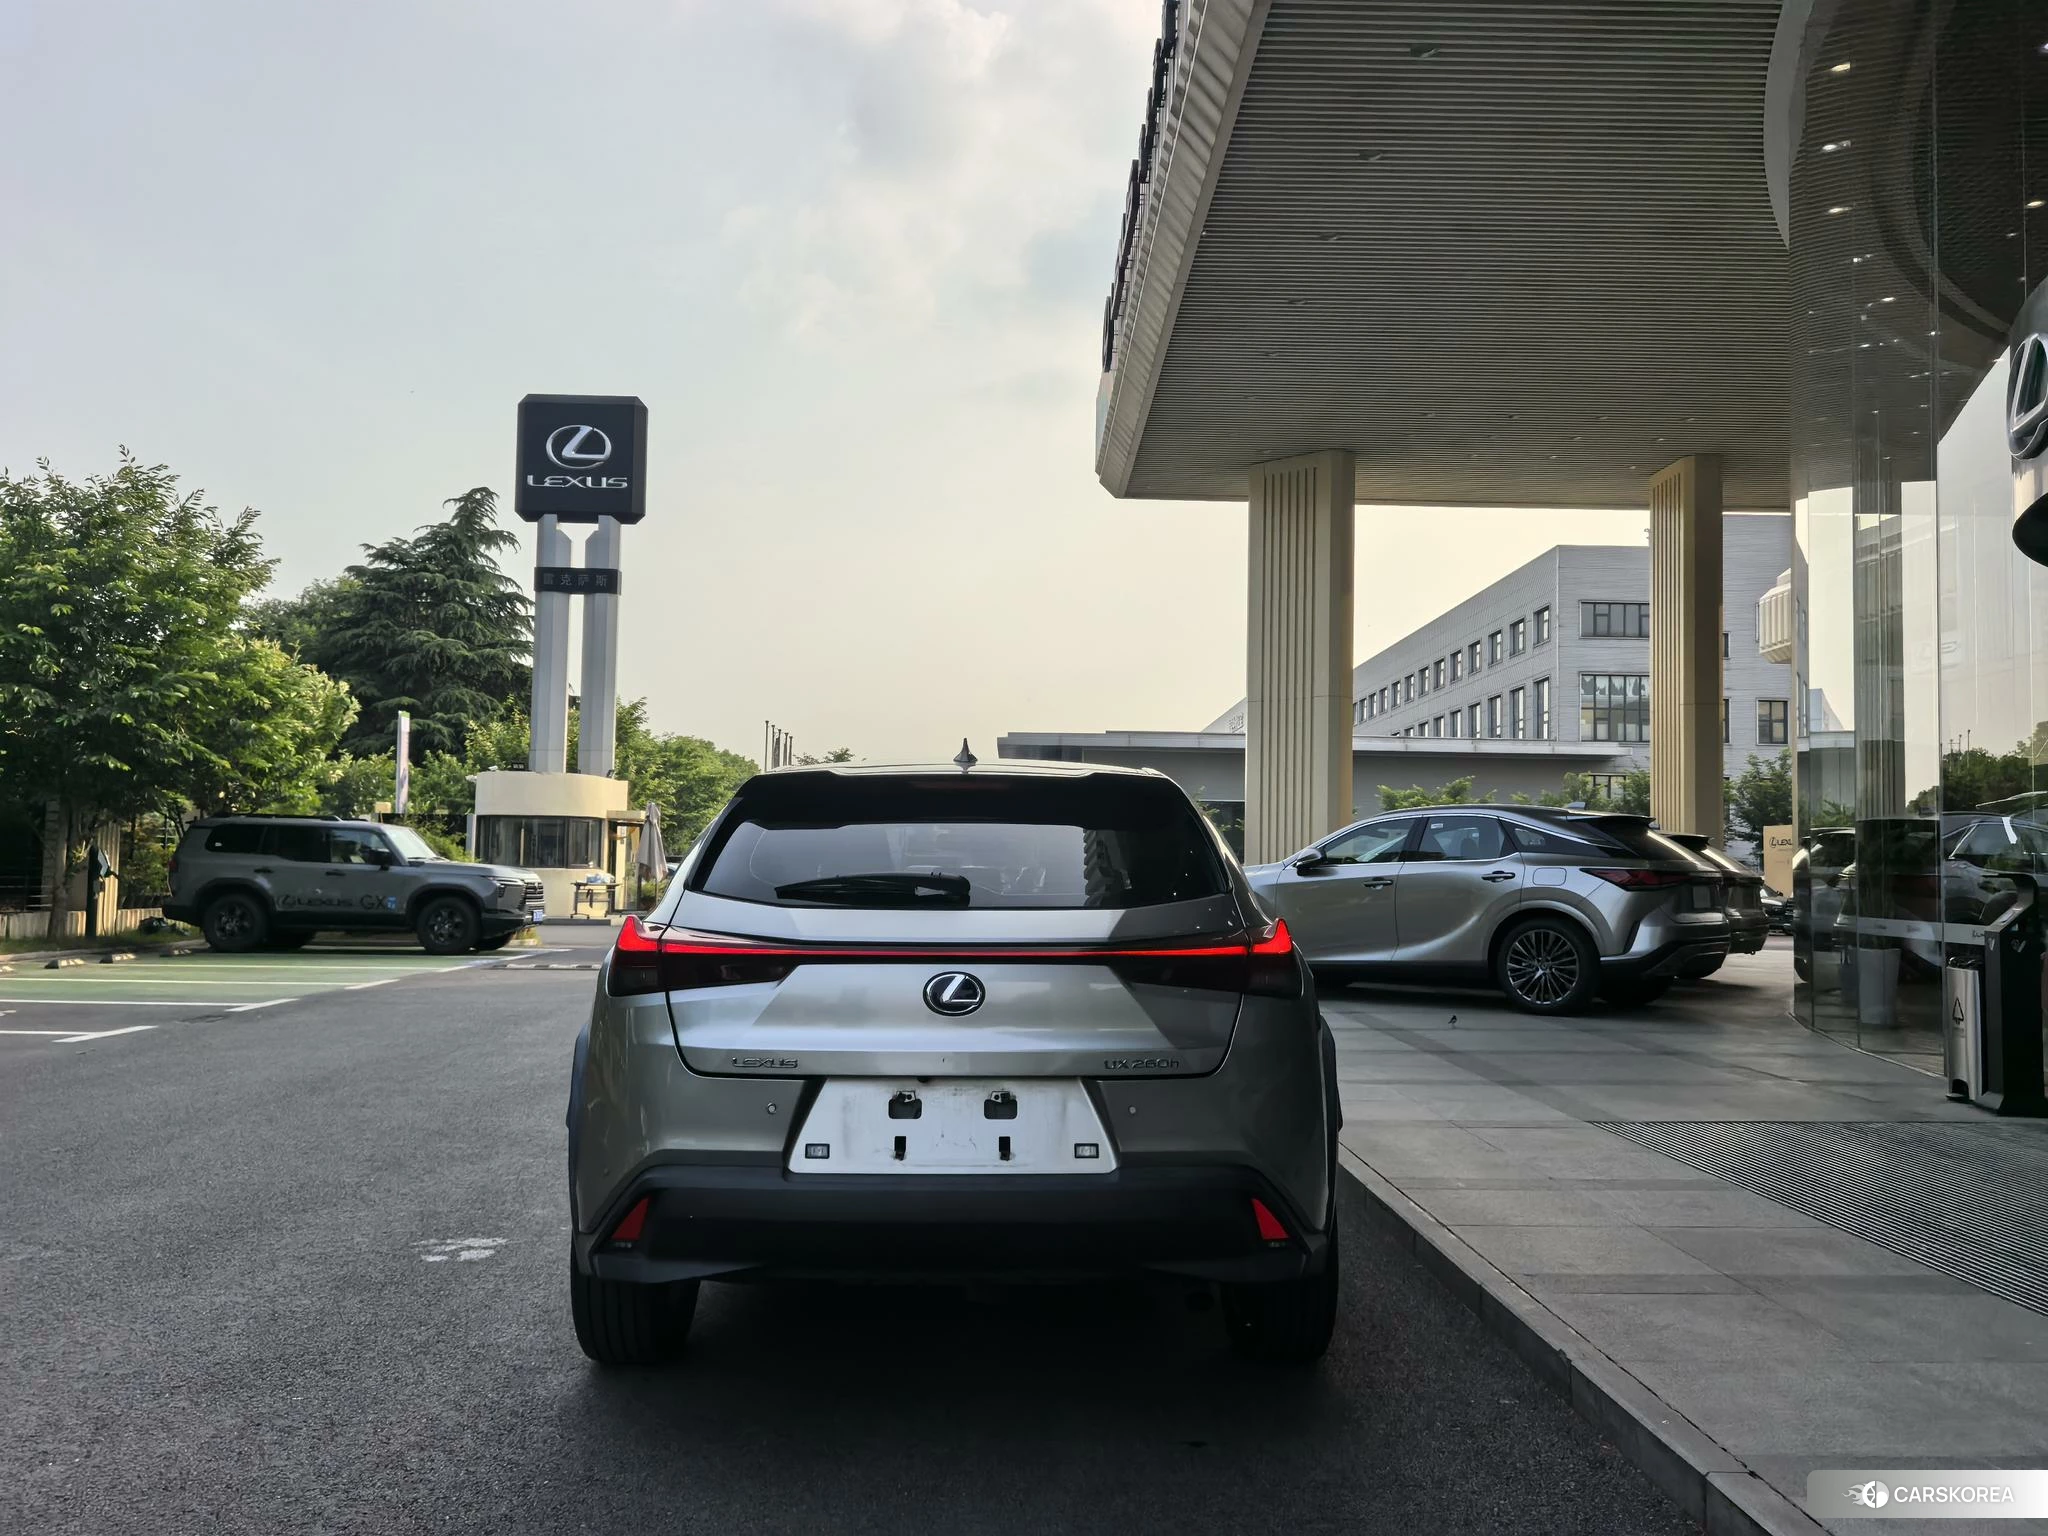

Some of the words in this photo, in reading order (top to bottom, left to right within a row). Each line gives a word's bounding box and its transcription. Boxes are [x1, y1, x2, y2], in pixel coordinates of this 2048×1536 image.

[527, 474, 628, 489] LEXUS
[360, 894, 385, 910] GX
[732, 1057, 798, 1069] LEXUS
[1104, 1059, 1130, 1070] UX
[1131, 1058, 1179, 1069] 260h
